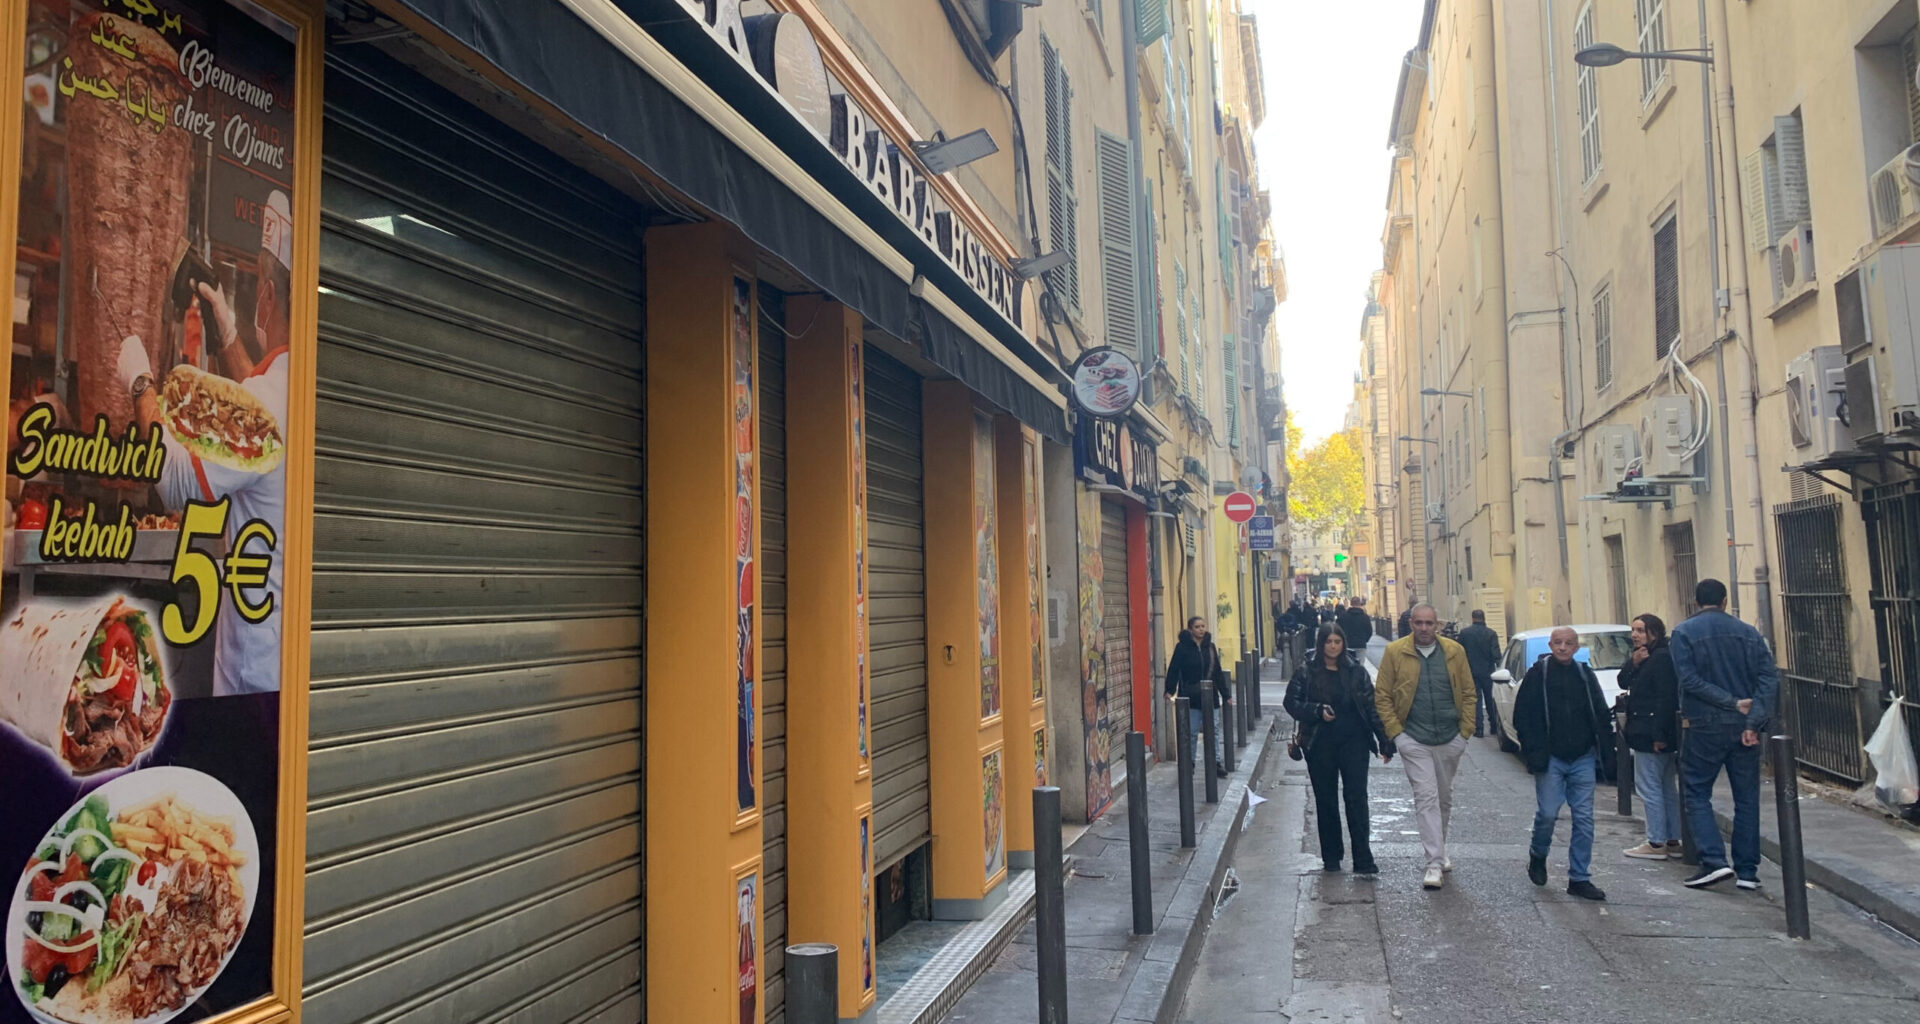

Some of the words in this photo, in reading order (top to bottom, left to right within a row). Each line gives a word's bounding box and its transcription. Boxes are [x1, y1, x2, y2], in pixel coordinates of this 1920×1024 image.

[91, 17, 136, 60] عند
[59, 56, 120, 100] حسن
[126, 75, 166, 133] بابا
[179, 40, 274, 113] Bienvenue
[174, 95, 216, 140] chez
[845, 94, 940, 252] BABA
[949, 210, 1014, 322] HSSEN
[15, 406, 164, 479] Sandwich
[1094, 420, 1119, 474] CHEZ
[43, 499, 133, 558] kebab
